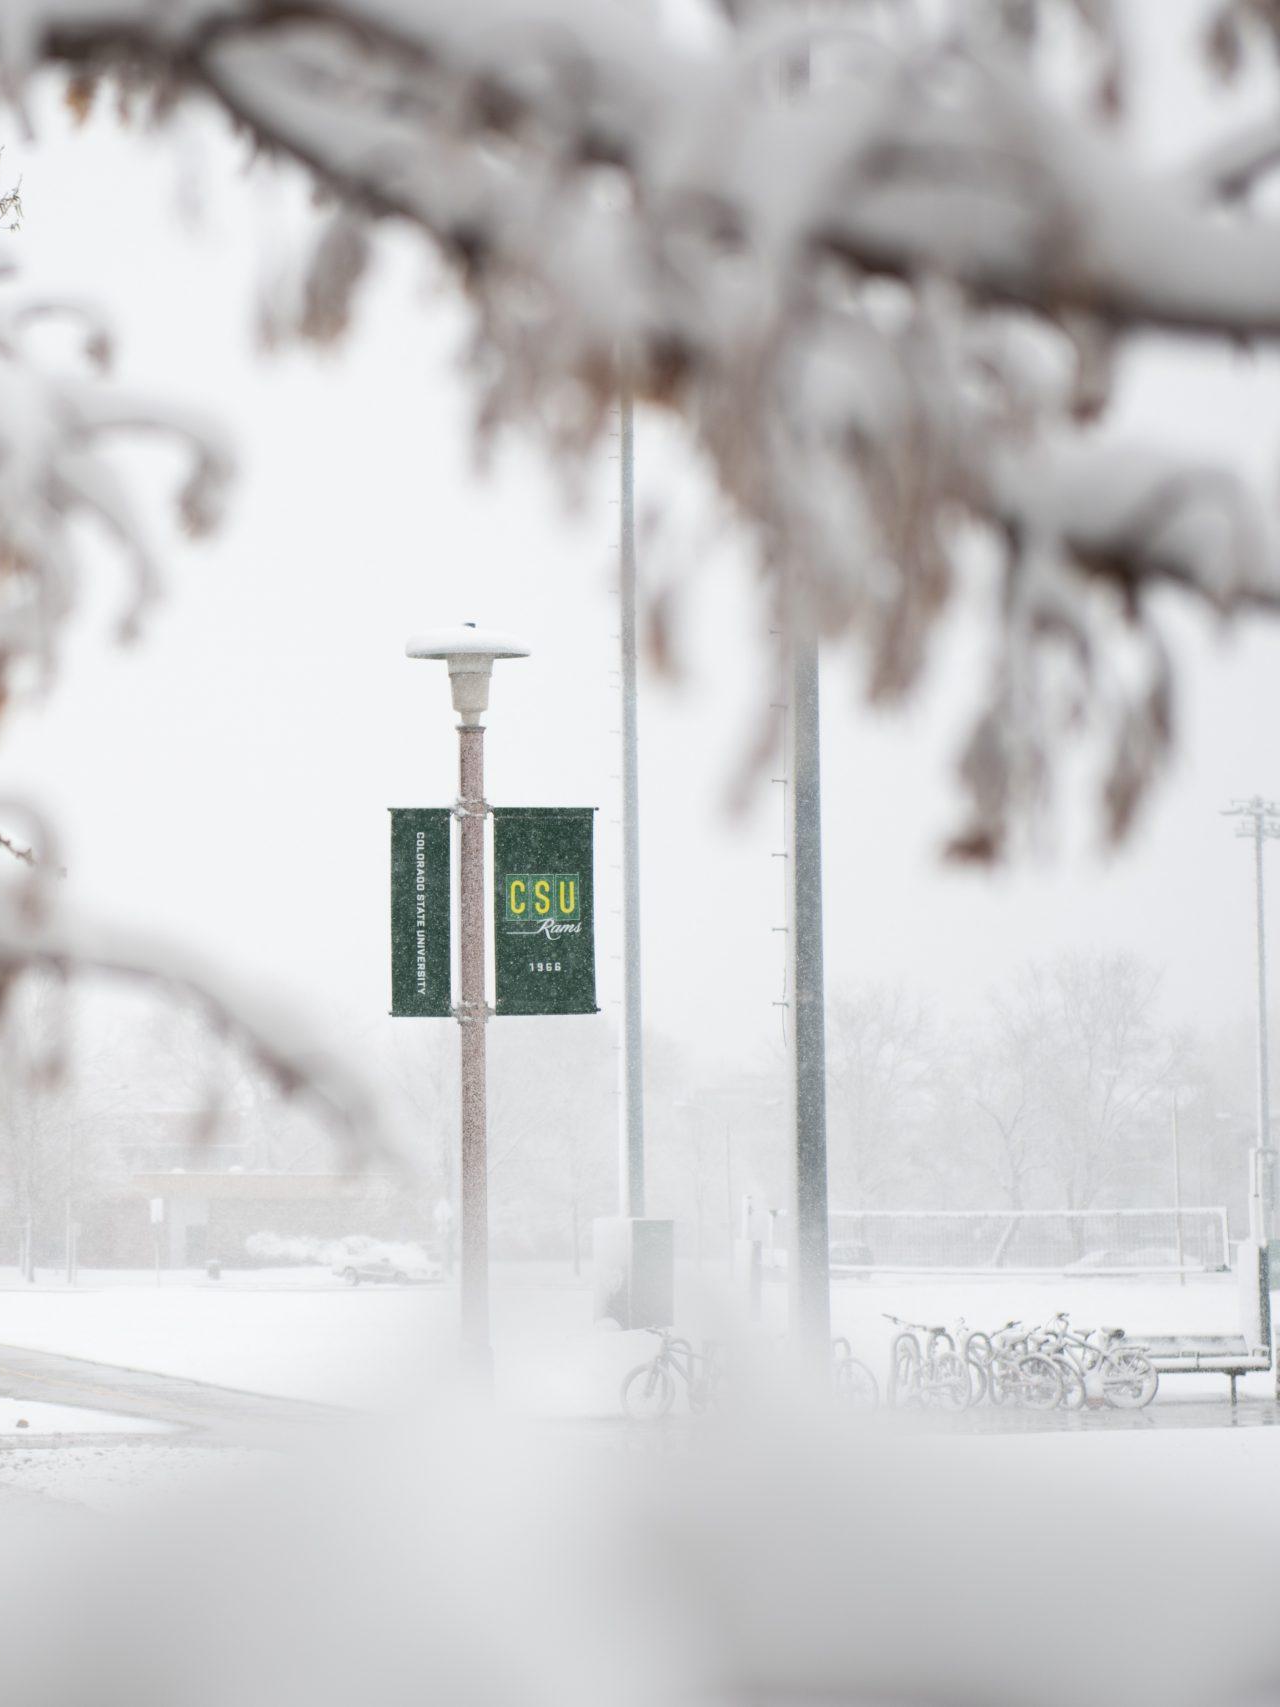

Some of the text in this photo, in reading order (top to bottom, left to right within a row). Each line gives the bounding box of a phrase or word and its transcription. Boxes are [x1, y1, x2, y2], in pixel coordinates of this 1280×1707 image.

[510, 880, 575, 914] CSU
[416, 831, 426, 995] COLORADO STATE UNIVERSITY
[506, 917, 582, 941] Rams
[529, 962, 562, 972] 1966
